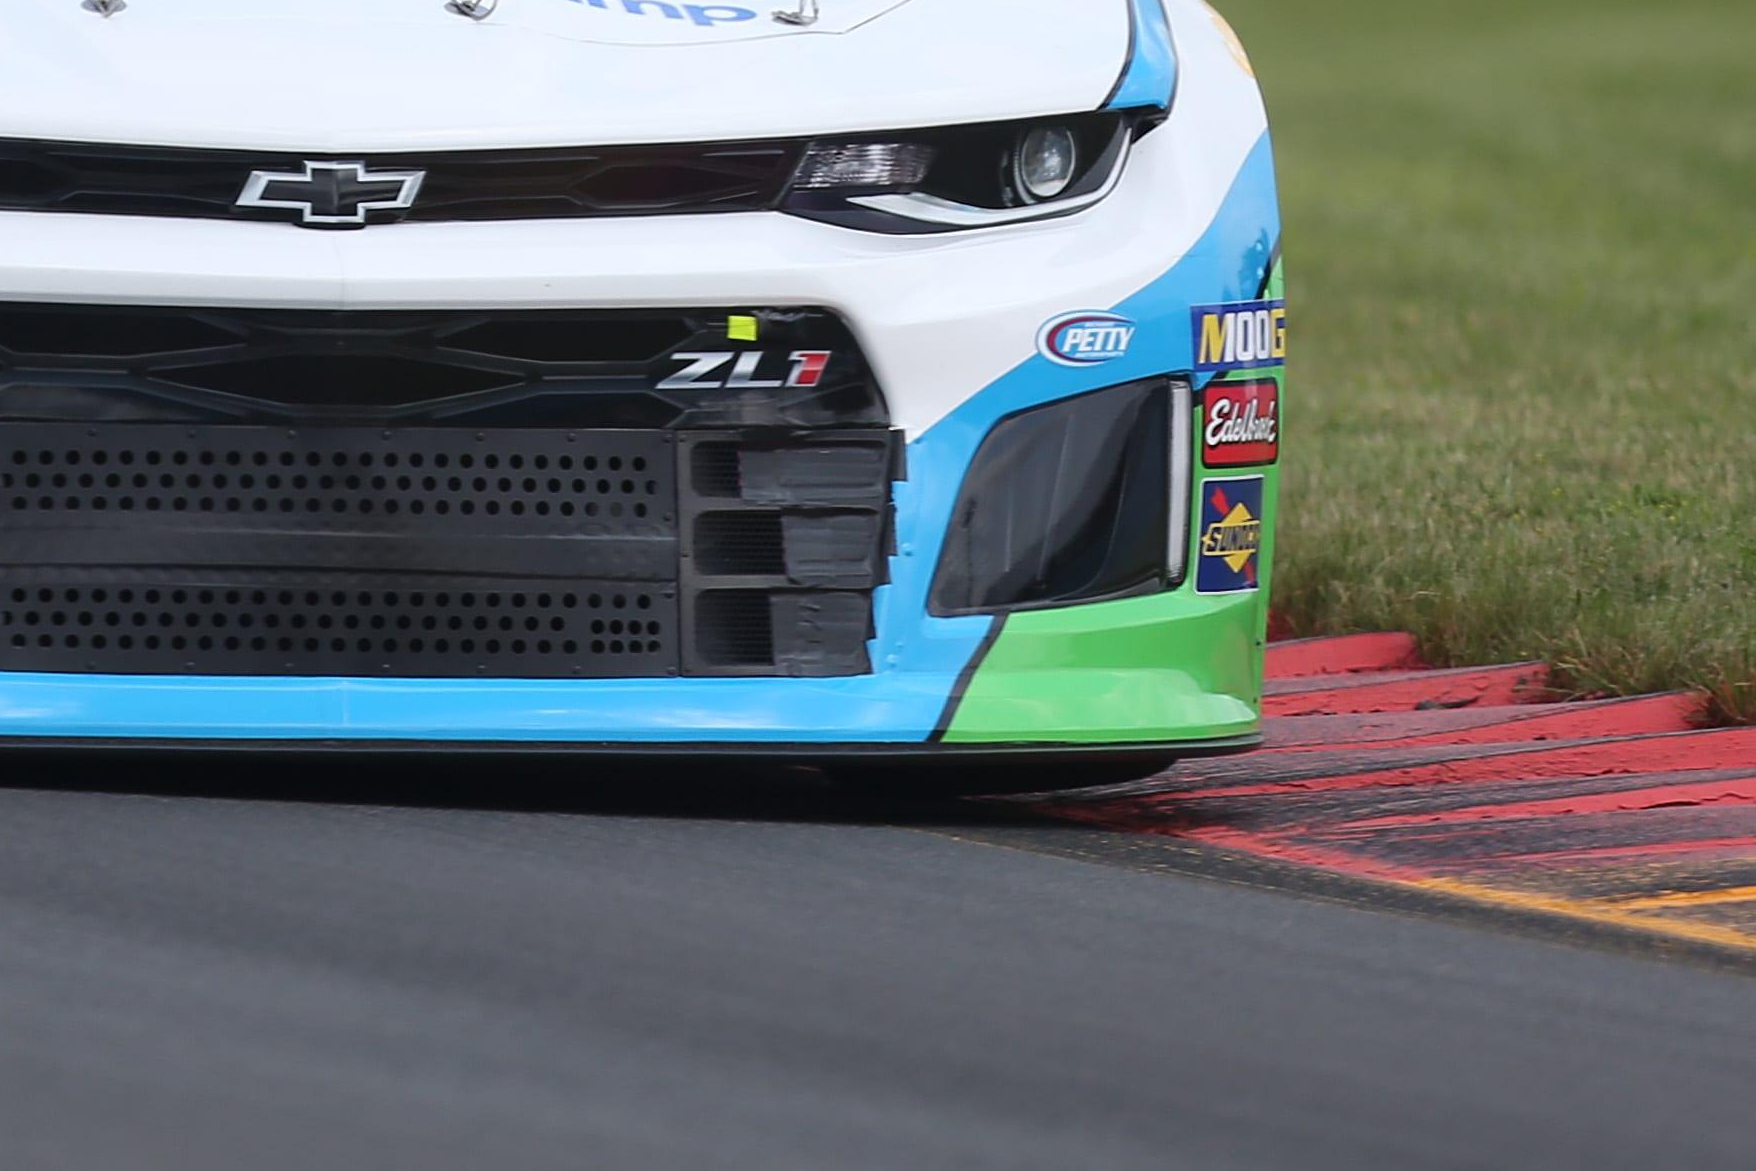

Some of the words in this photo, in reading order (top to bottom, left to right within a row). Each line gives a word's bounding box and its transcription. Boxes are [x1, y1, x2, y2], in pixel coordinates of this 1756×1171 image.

[1062, 327, 1136, 352] PETTY
[1199, 309, 1286, 364] MOOG
[655, 350, 832, 389] ZL1
